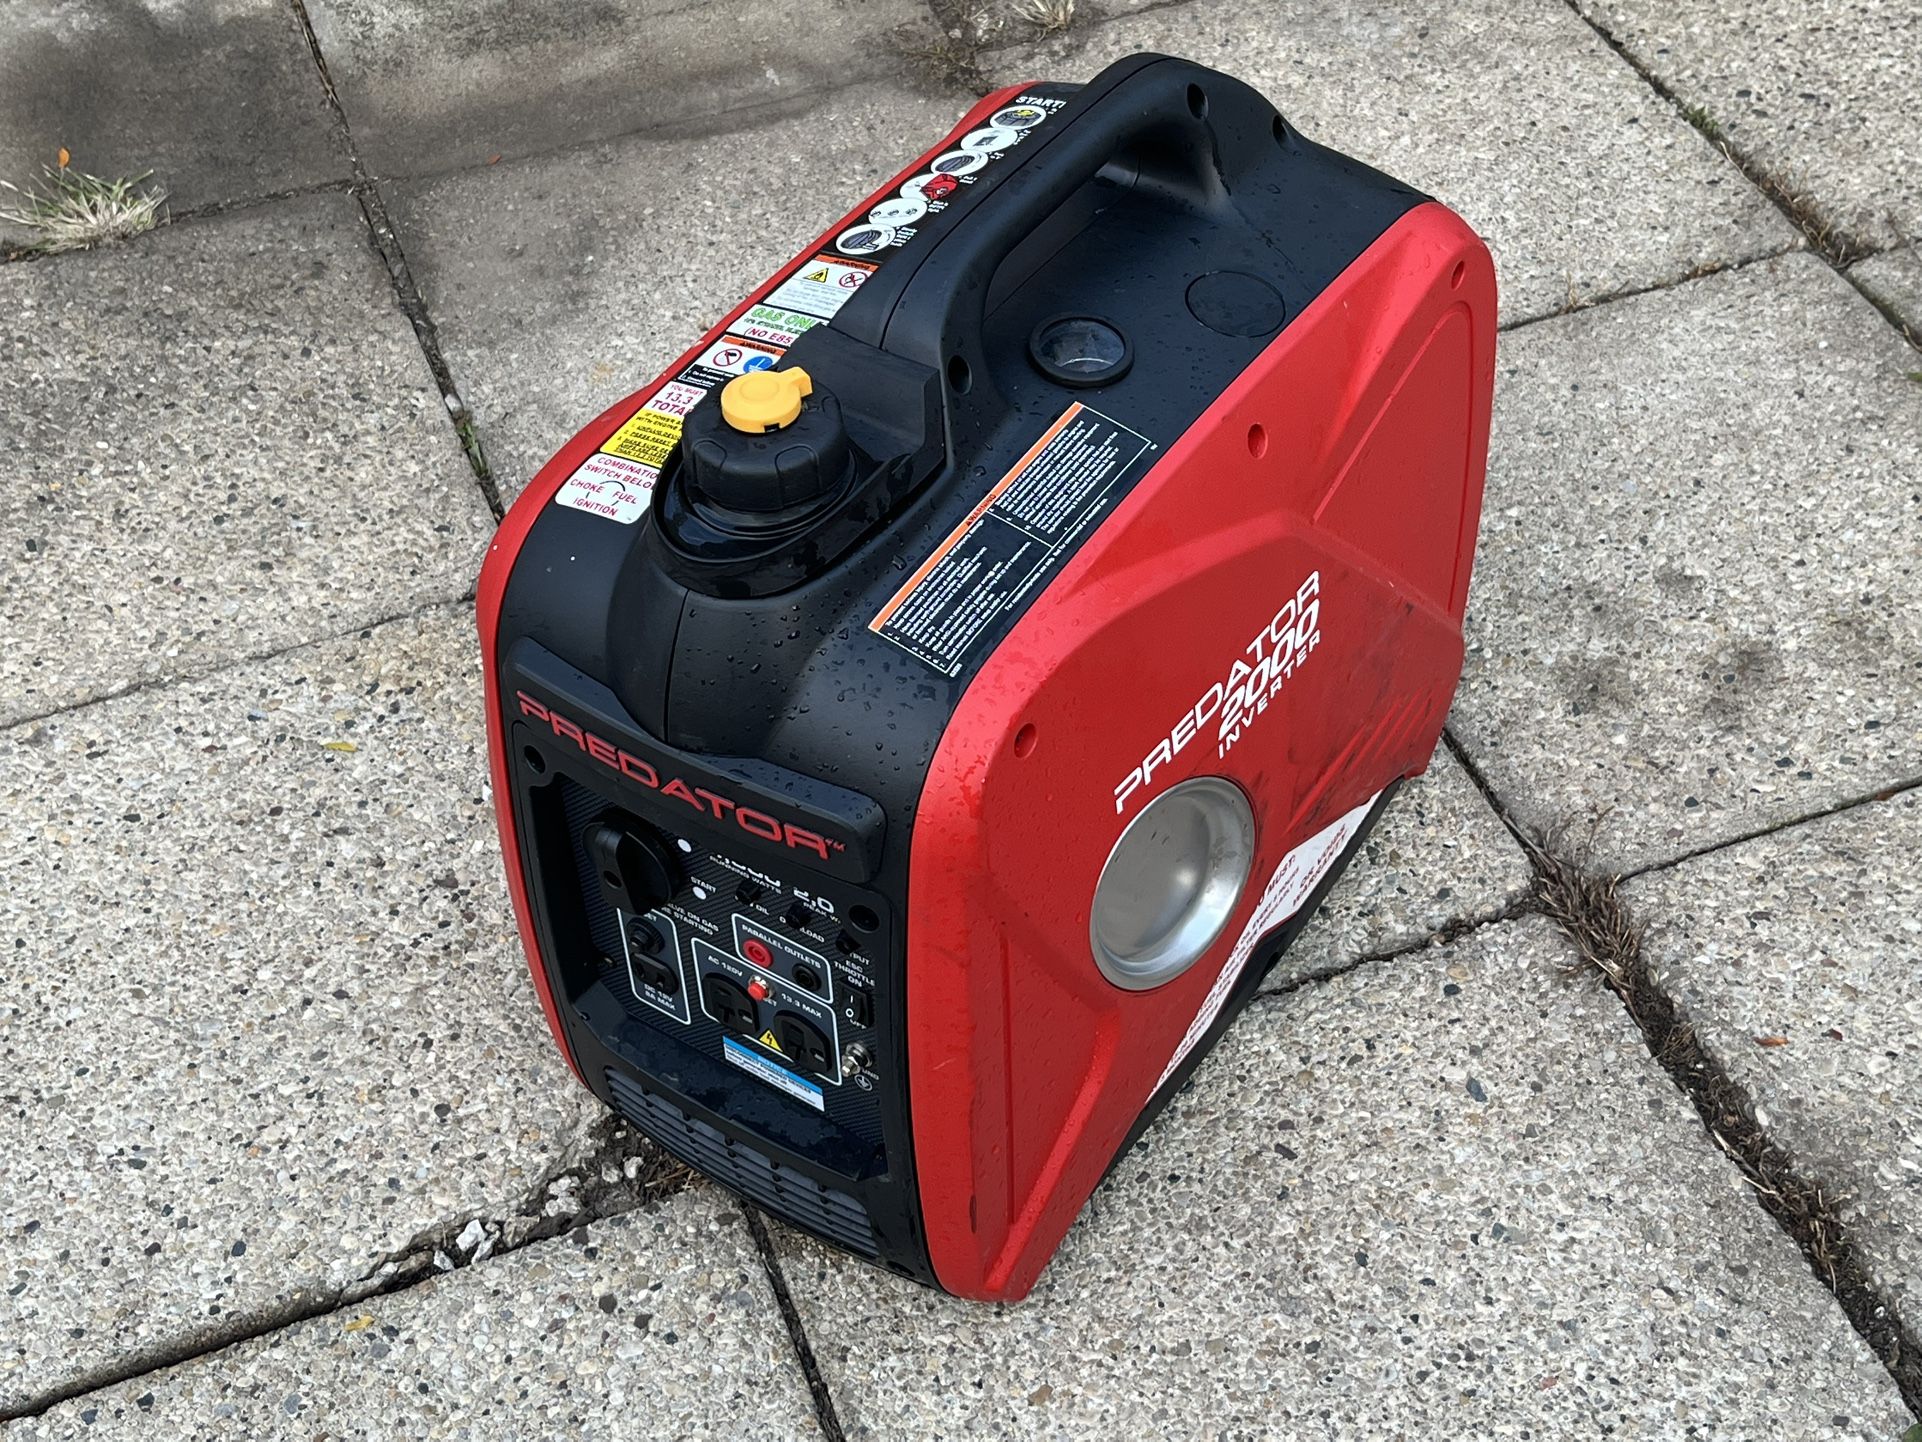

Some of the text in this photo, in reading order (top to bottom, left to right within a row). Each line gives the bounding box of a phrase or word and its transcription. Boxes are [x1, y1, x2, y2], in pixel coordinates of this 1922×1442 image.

[1015, 96, 1067, 109] START!
[751, 307, 786, 322] GAS
[665, 391, 694, 406] 13.3
[651, 400, 687, 416] TOTA
[597, 456, 660, 480] COMBINATIO
[584, 463, 654, 490] SWITCH BELO
[570, 478, 605, 494] CHOKE
[612, 491, 639, 505] FUEL
[573, 497, 620, 517] IGNITION
[1217, 599, 1320, 742] 2000
[1113, 570, 1321, 815] PREDATOR
[1217, 629, 1321, 760] INVERTER
[516, 689, 831, 861] PREDATOR
[690, 876, 717, 893] START
[751, 875, 782, 895] WATTS
[755, 904, 770, 916] OIL
[803, 901, 828, 917] PEAK
[673, 911, 714, 936] STARTING
[702, 919, 719, 931] GAS
[741, 924, 821, 969] PARALLEL OUTLETS
[707, 955, 720, 965] AC
[845, 960, 863, 973] ESC
[833, 961, 876, 987] THROTTLE
[847, 975, 863, 987] ON
[801, 1003, 823, 1019] MAX
